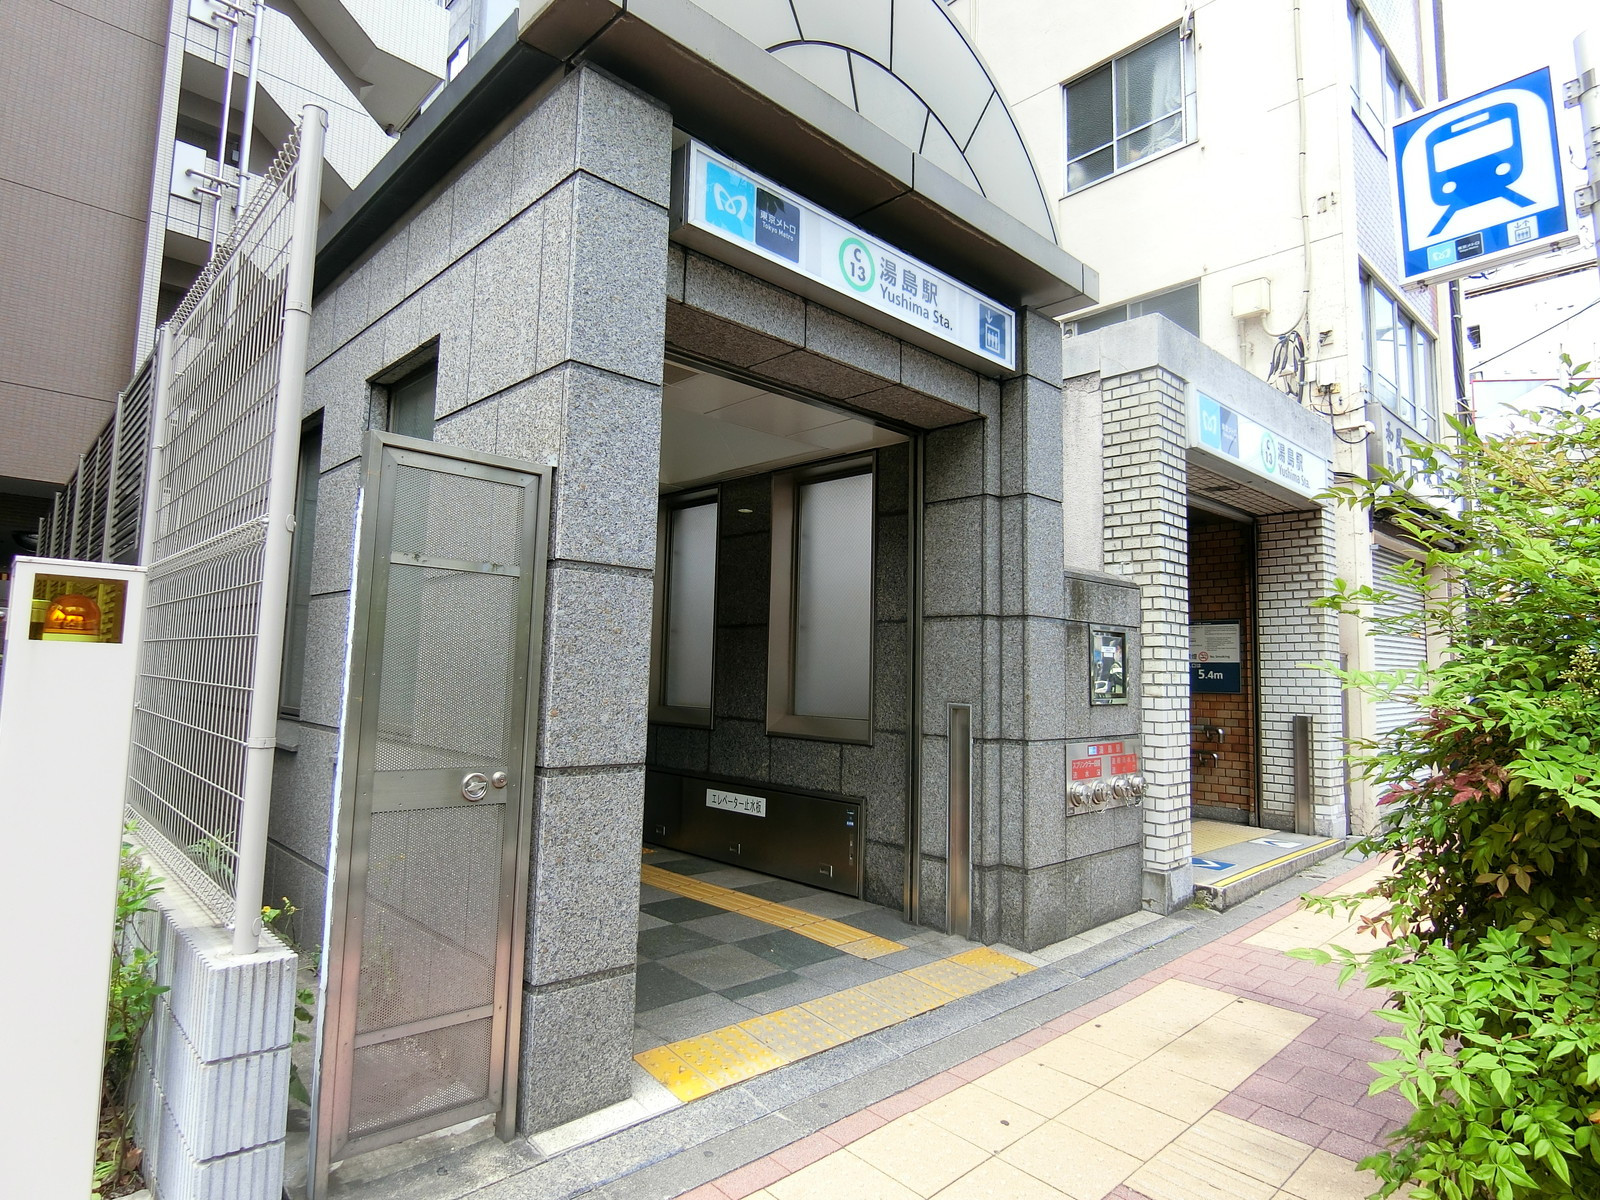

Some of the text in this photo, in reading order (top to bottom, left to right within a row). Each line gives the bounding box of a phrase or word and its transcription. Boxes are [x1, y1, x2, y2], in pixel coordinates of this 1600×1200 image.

[759, 209, 797, 235] 東京メトロ
[762, 221, 795, 242] Tokyo Metro
[853, 247, 862, 263] C
[849, 261, 866, 282] 13
[879, 256, 938, 307] 湯島駅
[880, 284, 953, 331] Yushima Sta.
[1266, 439, 1271, 450] C
[1265, 451, 1273, 465] 13
[1277, 441, 1304, 473] 湯島駅
[1278, 464, 1311, 489] Yushima Sta.
[1198, 669, 1223, 680] 5.4m
[712, 794, 762, 814] エレベーター止水板
